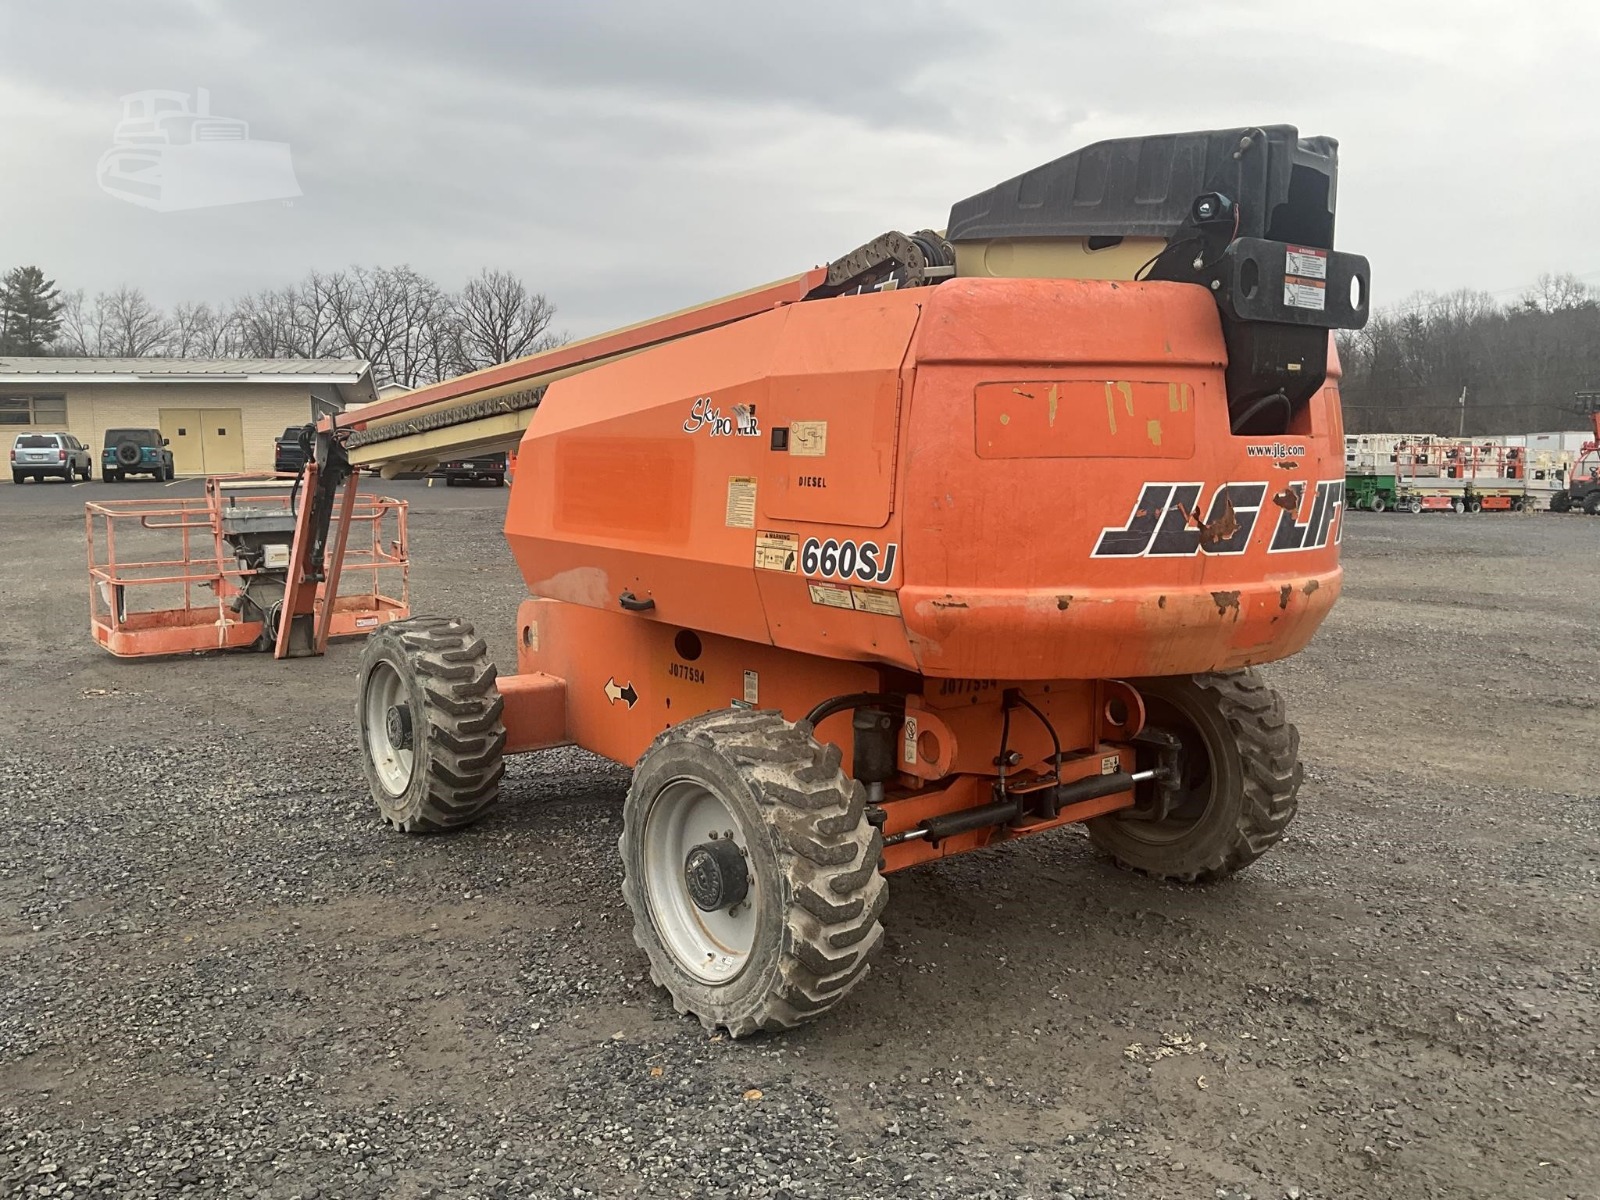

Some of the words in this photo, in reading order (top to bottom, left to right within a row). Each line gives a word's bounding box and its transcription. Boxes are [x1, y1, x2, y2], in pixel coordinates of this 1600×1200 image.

[683, 397, 720, 437] Sky
[1247, 443, 1305, 458] www.jlg.com
[798, 476, 827, 489] DIESEL
[1090, 481, 1269, 558] JLG
[801, 536, 898, 584] 660SJ
[668, 662, 705, 684] J077594
